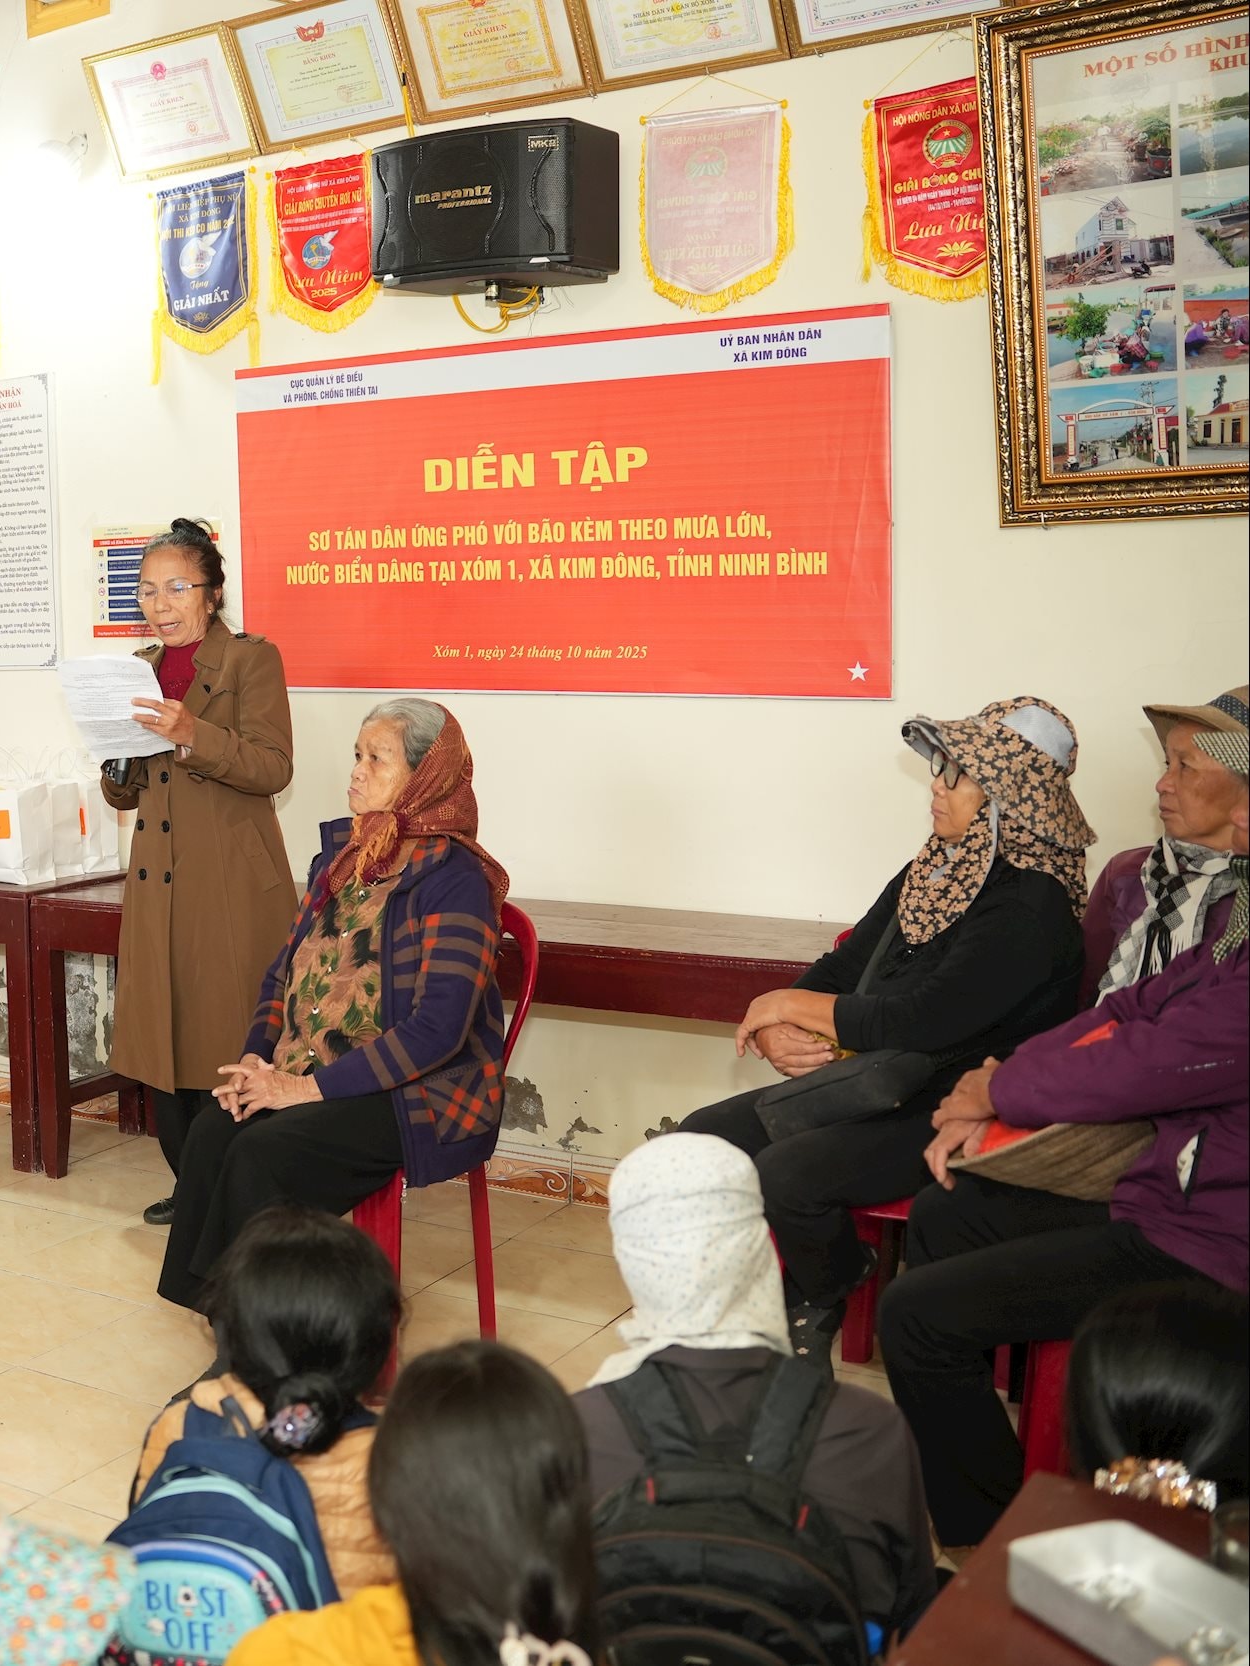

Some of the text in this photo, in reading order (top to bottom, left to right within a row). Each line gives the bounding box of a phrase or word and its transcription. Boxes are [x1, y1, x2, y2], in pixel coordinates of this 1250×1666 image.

[485, 24, 507, 34] KHEN
[320, 53, 336, 61] KHEN
[1083, 33, 1248, 77] MỘT SỐ HÌNH
[893, 115, 906, 126] HỘI
[908, 111, 930, 123] NÔNG
[932, 106, 948, 118] DÂN
[962, 101, 976, 113] KIM
[894, 177, 918, 194] GIẢI
[415, 185, 492, 204] marantz
[437, 198, 492, 209] PROFESSIONAL
[904, 221, 942, 241] Lưu
[321, 269, 363, 285] Niệm
[174, 287, 229, 311] GIẢI NHẤT
[312, 288, 337, 298] 2025
[737, 335, 759, 345] BAN
[763, 330, 794, 343] NHÂN
[799, 328, 821, 340] DÂN
[734, 347, 807, 362] XÃ KIM ĐÔNG
[290, 379, 304, 389] CỤC
[327, 375, 334, 384] LÝ
[336, 374, 345, 383] ĐÊ
[346, 386, 365, 397] THIÊN
[368, 386, 377, 394] TAI
[424, 441, 648, 493] DIỄN TẬP
[309, 511, 772, 551] SƠ TÁN DÂN ỨNG PHÓ VỚI BÃO KÈM THEO MƯA LỚN,
[286, 548, 827, 586] NƯỚC BIỂN DÂNG TẠI XÓM 1, XÃ KIM ĐÔNG, TỈNH NINH BÌNH
[432, 645, 647, 661] Xóm 1, ngày 24 tháng 10 năm 2025
[165, 1618, 215, 1652] OFF
